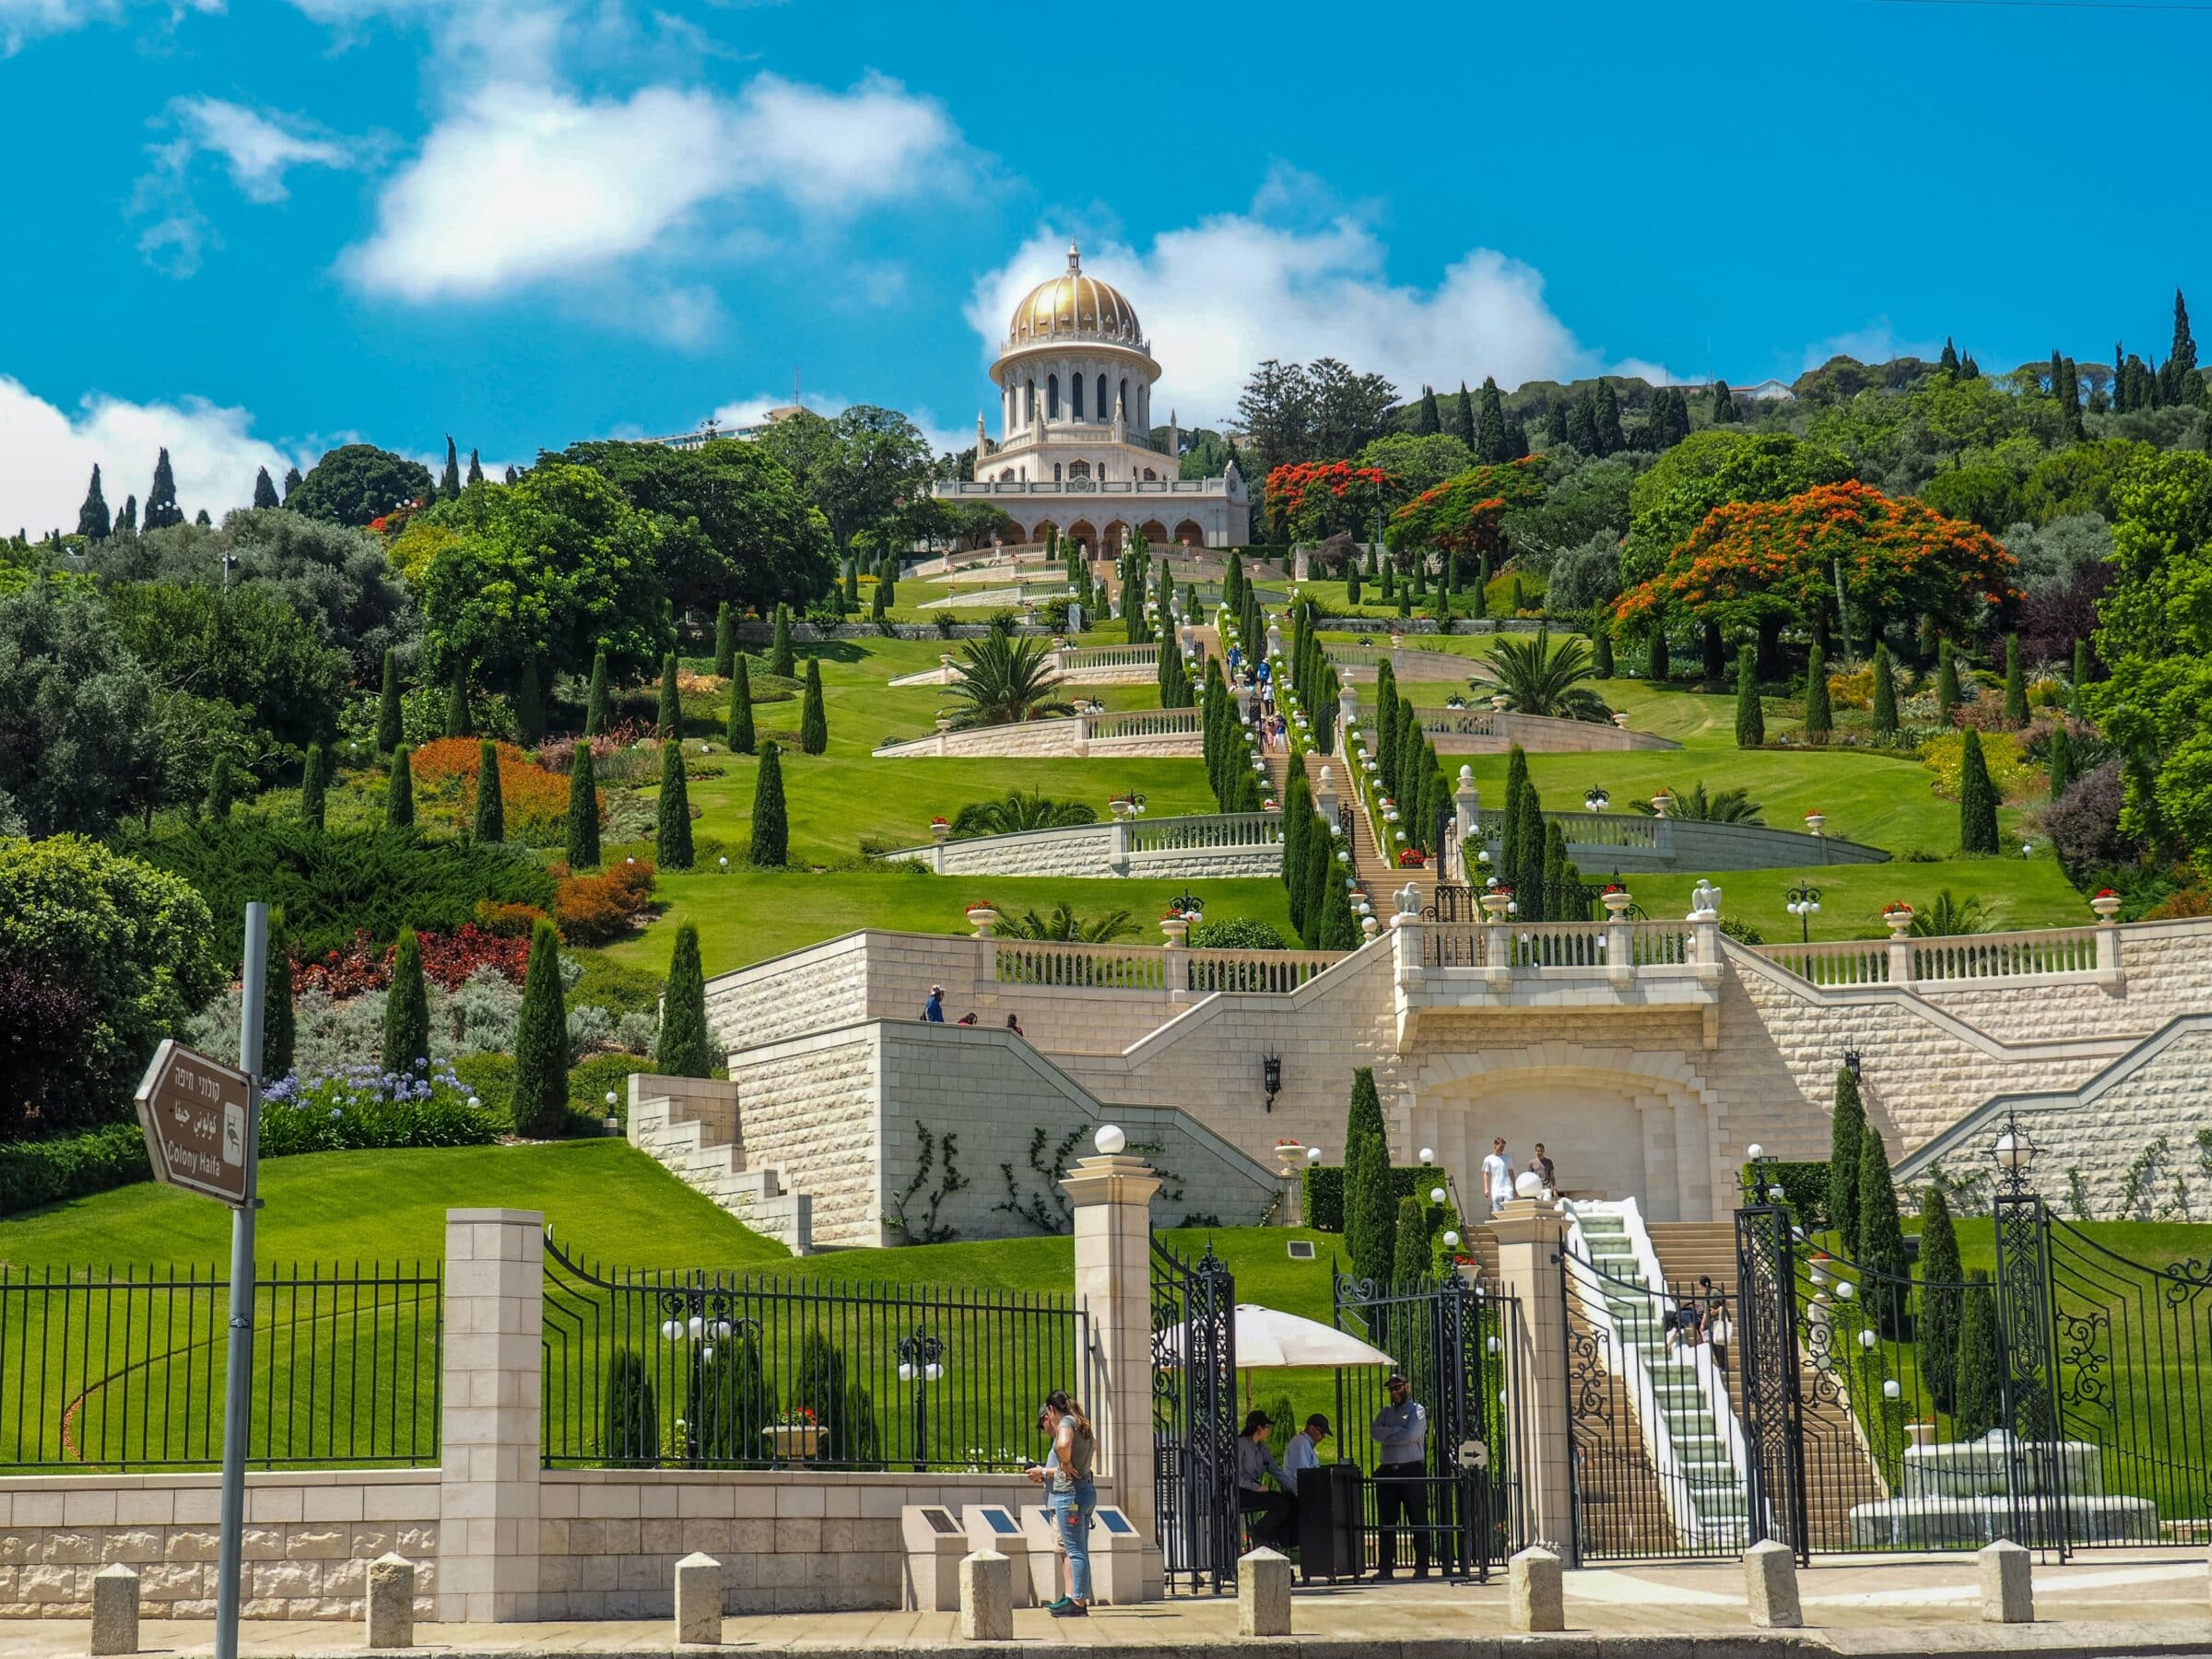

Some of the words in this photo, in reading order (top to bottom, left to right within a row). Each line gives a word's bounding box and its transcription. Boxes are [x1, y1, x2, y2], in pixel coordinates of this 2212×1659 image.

[175, 1066, 194, 1091] חיפה
[198, 1076, 220, 1103] קולוני
[174, 1100, 191, 1127] حيفا
[168, 1140, 196, 1173] Colony
[199, 1153, 220, 1177] Haifa
